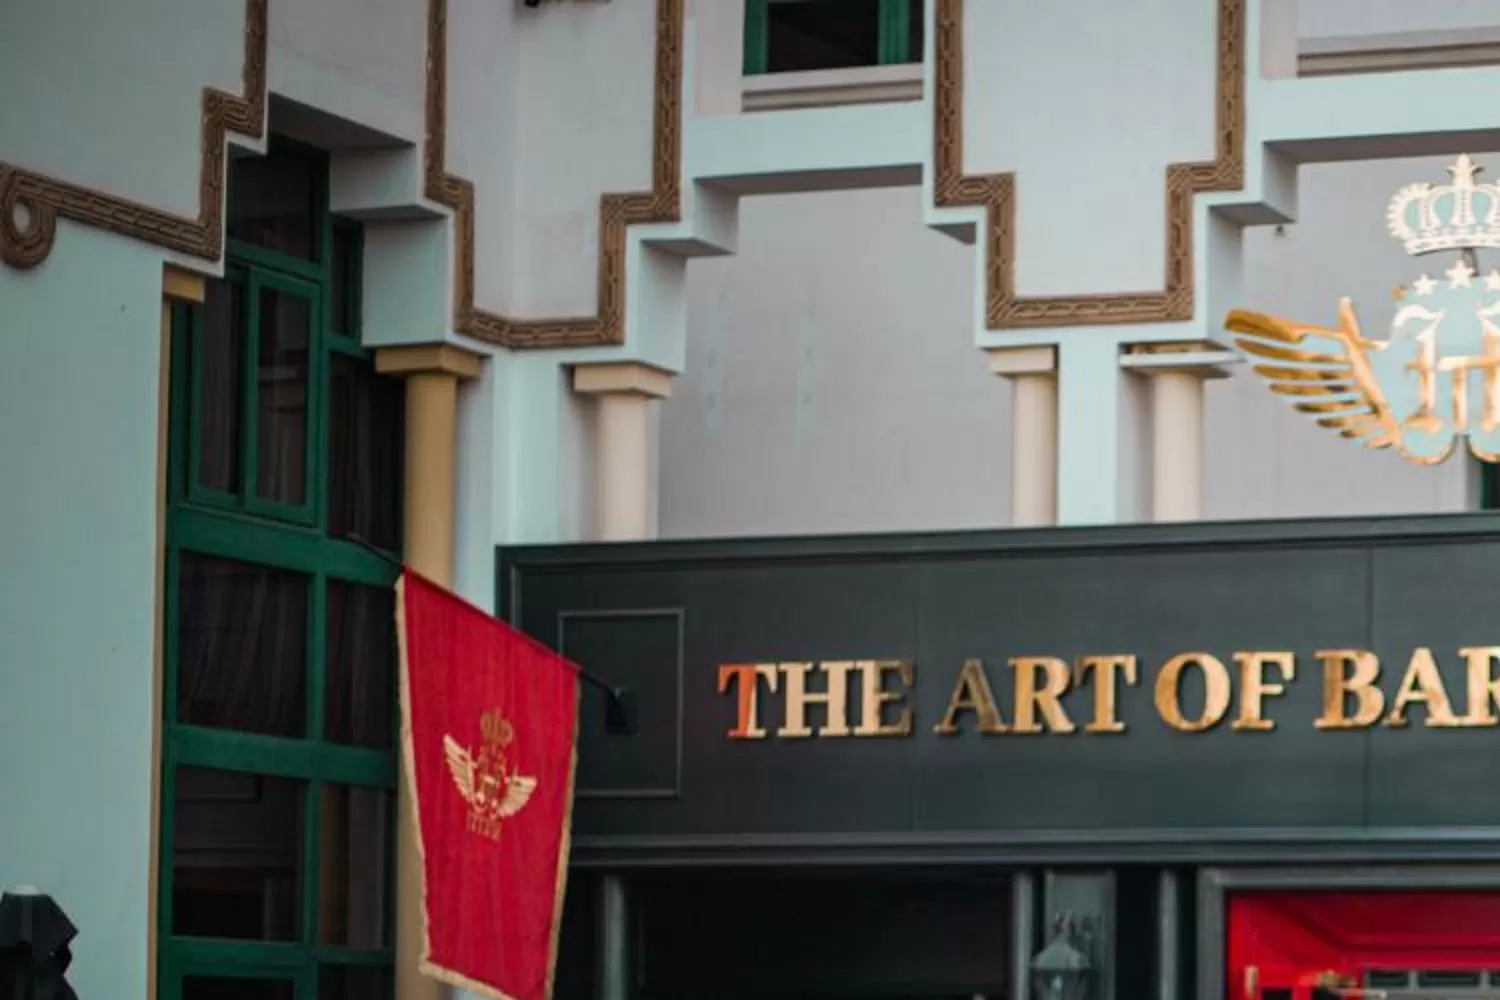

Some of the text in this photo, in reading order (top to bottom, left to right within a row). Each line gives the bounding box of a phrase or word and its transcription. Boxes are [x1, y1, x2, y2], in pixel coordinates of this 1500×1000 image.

[718, 659, 914, 739] THE
[934, 654, 1137, 735] ART
[1153, 650, 1295, 732] OF
